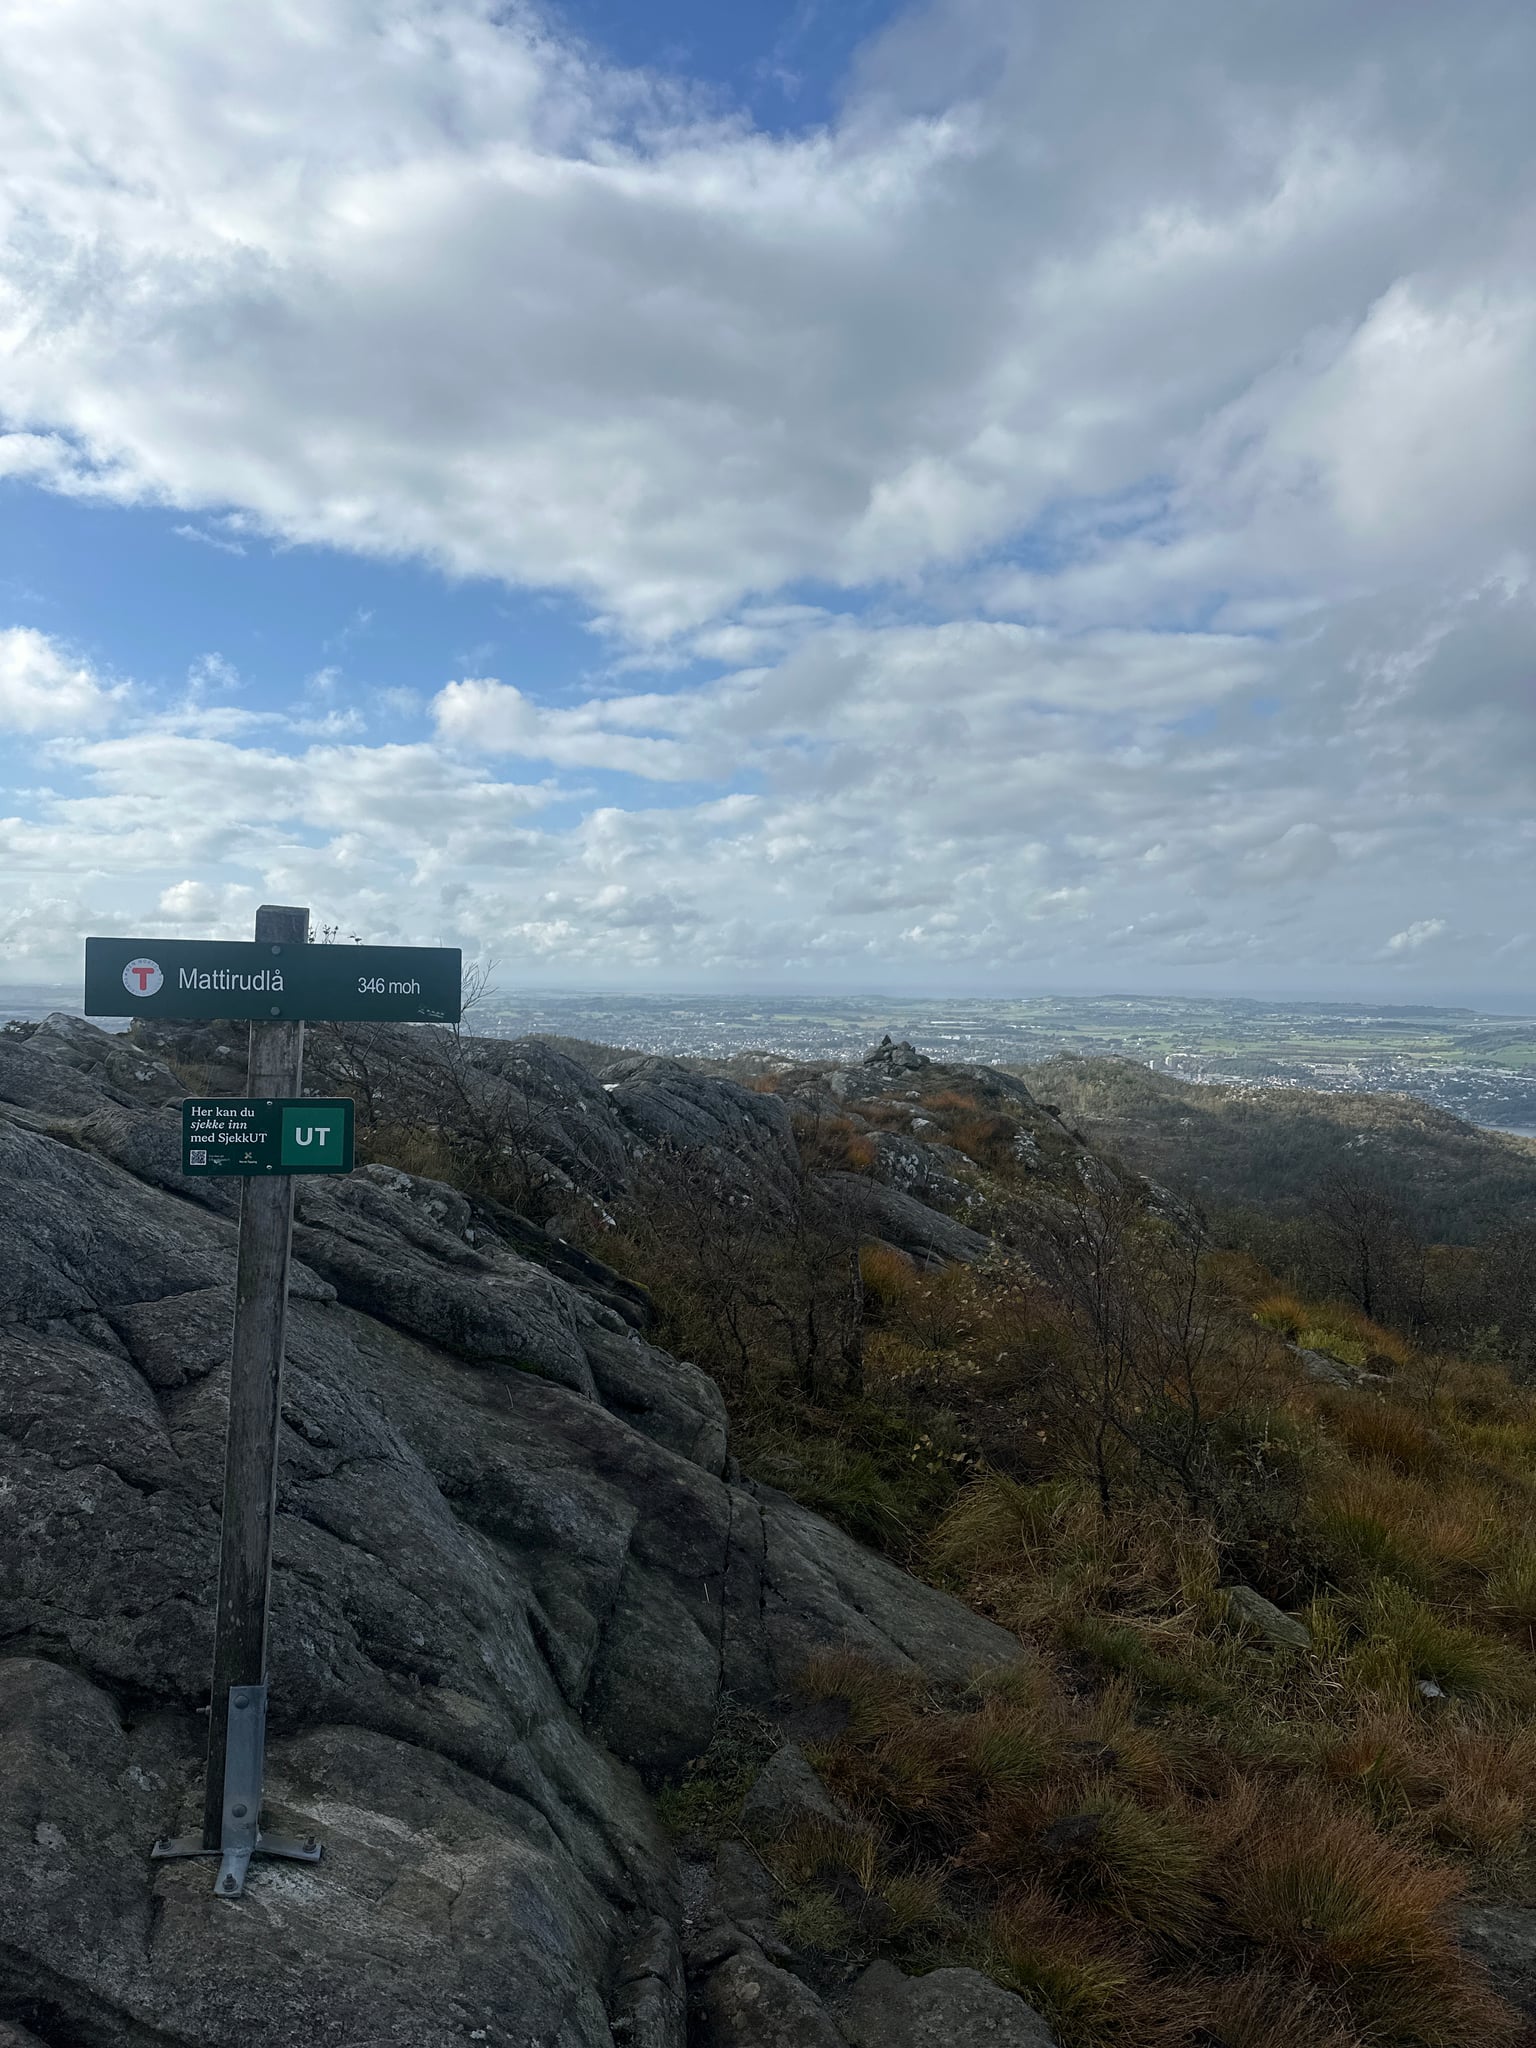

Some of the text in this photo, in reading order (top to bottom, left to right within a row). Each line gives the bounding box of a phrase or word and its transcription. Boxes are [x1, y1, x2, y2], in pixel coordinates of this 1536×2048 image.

[132, 967, 155, 991] T
[178, 968, 284, 992] Mattirudlå
[357, 977, 421, 995] 346 moh
[191, 1106, 255, 1117] Her kan du
[190, 1119, 248, 1131] sjekke inn
[190, 1133, 268, 1145] med SjekkUT
[295, 1127, 331, 1146] UT
